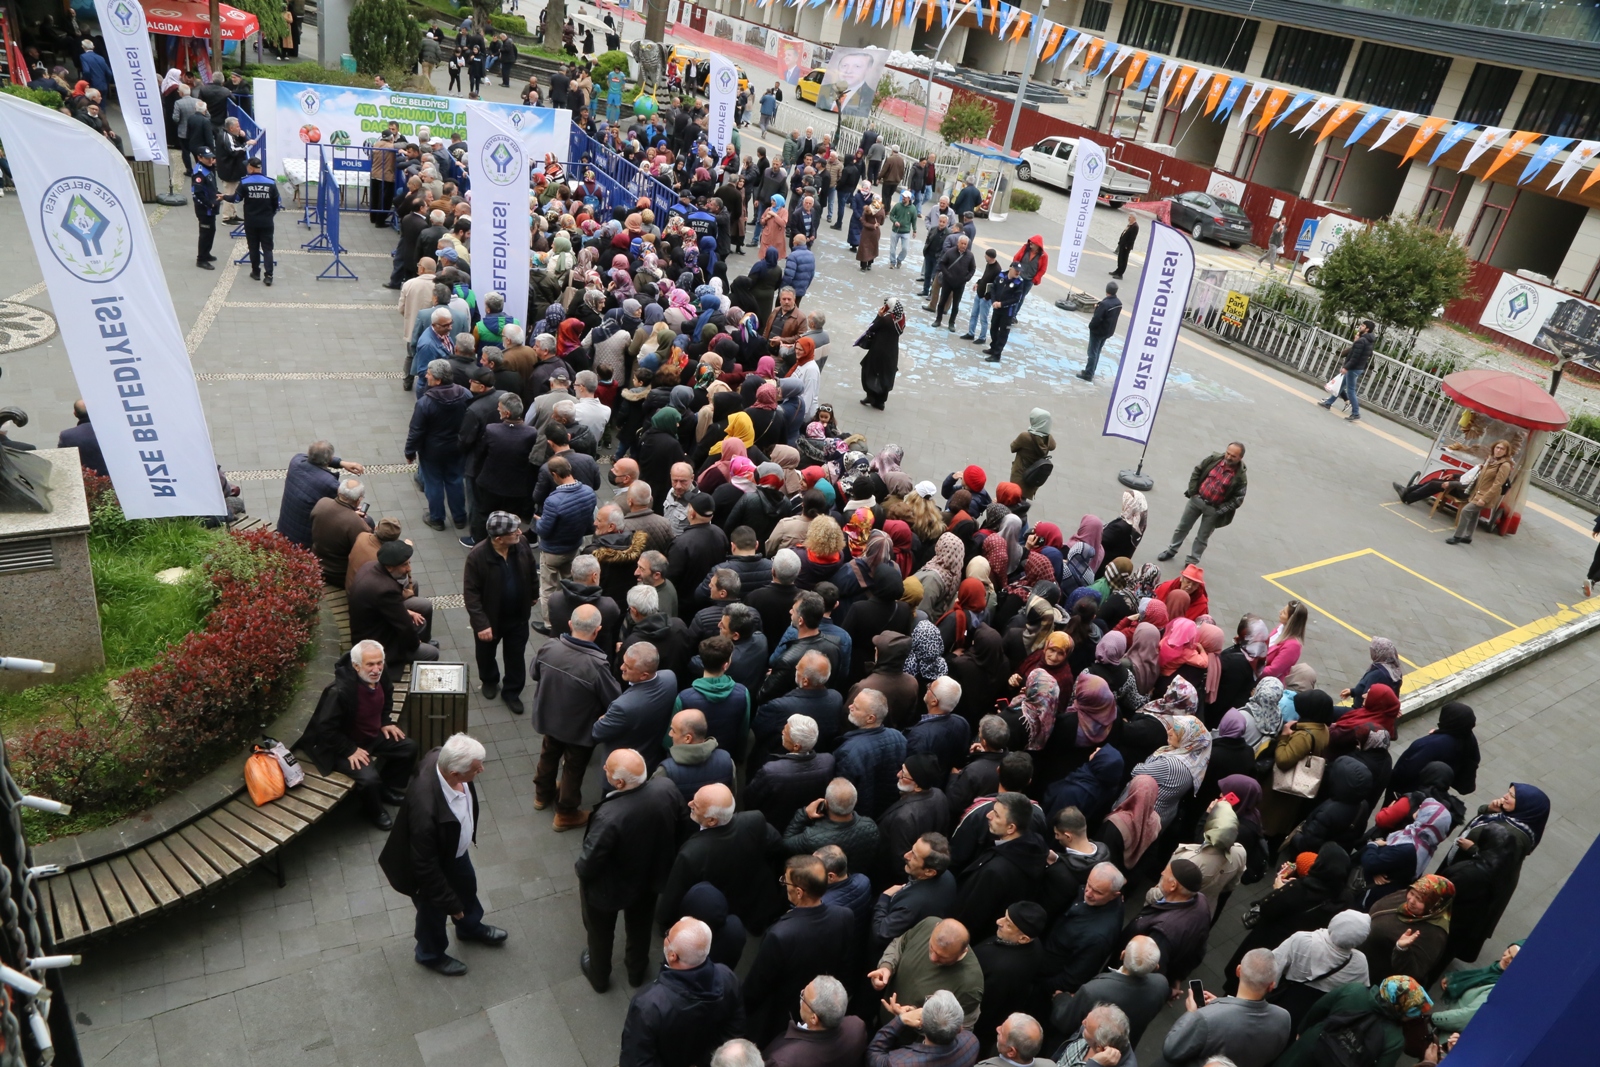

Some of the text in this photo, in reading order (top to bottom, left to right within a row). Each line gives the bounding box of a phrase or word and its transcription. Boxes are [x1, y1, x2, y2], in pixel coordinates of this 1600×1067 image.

[390, 94, 449, 109] RİZE BELEDİYESİ
[355, 102, 467, 125] ATA TOHUMU VE Fİ
[341, 160, 362, 168] POLİS
[1228, 297, 1245, 309] Park
[1226, 304, 1244, 318] Taksi
